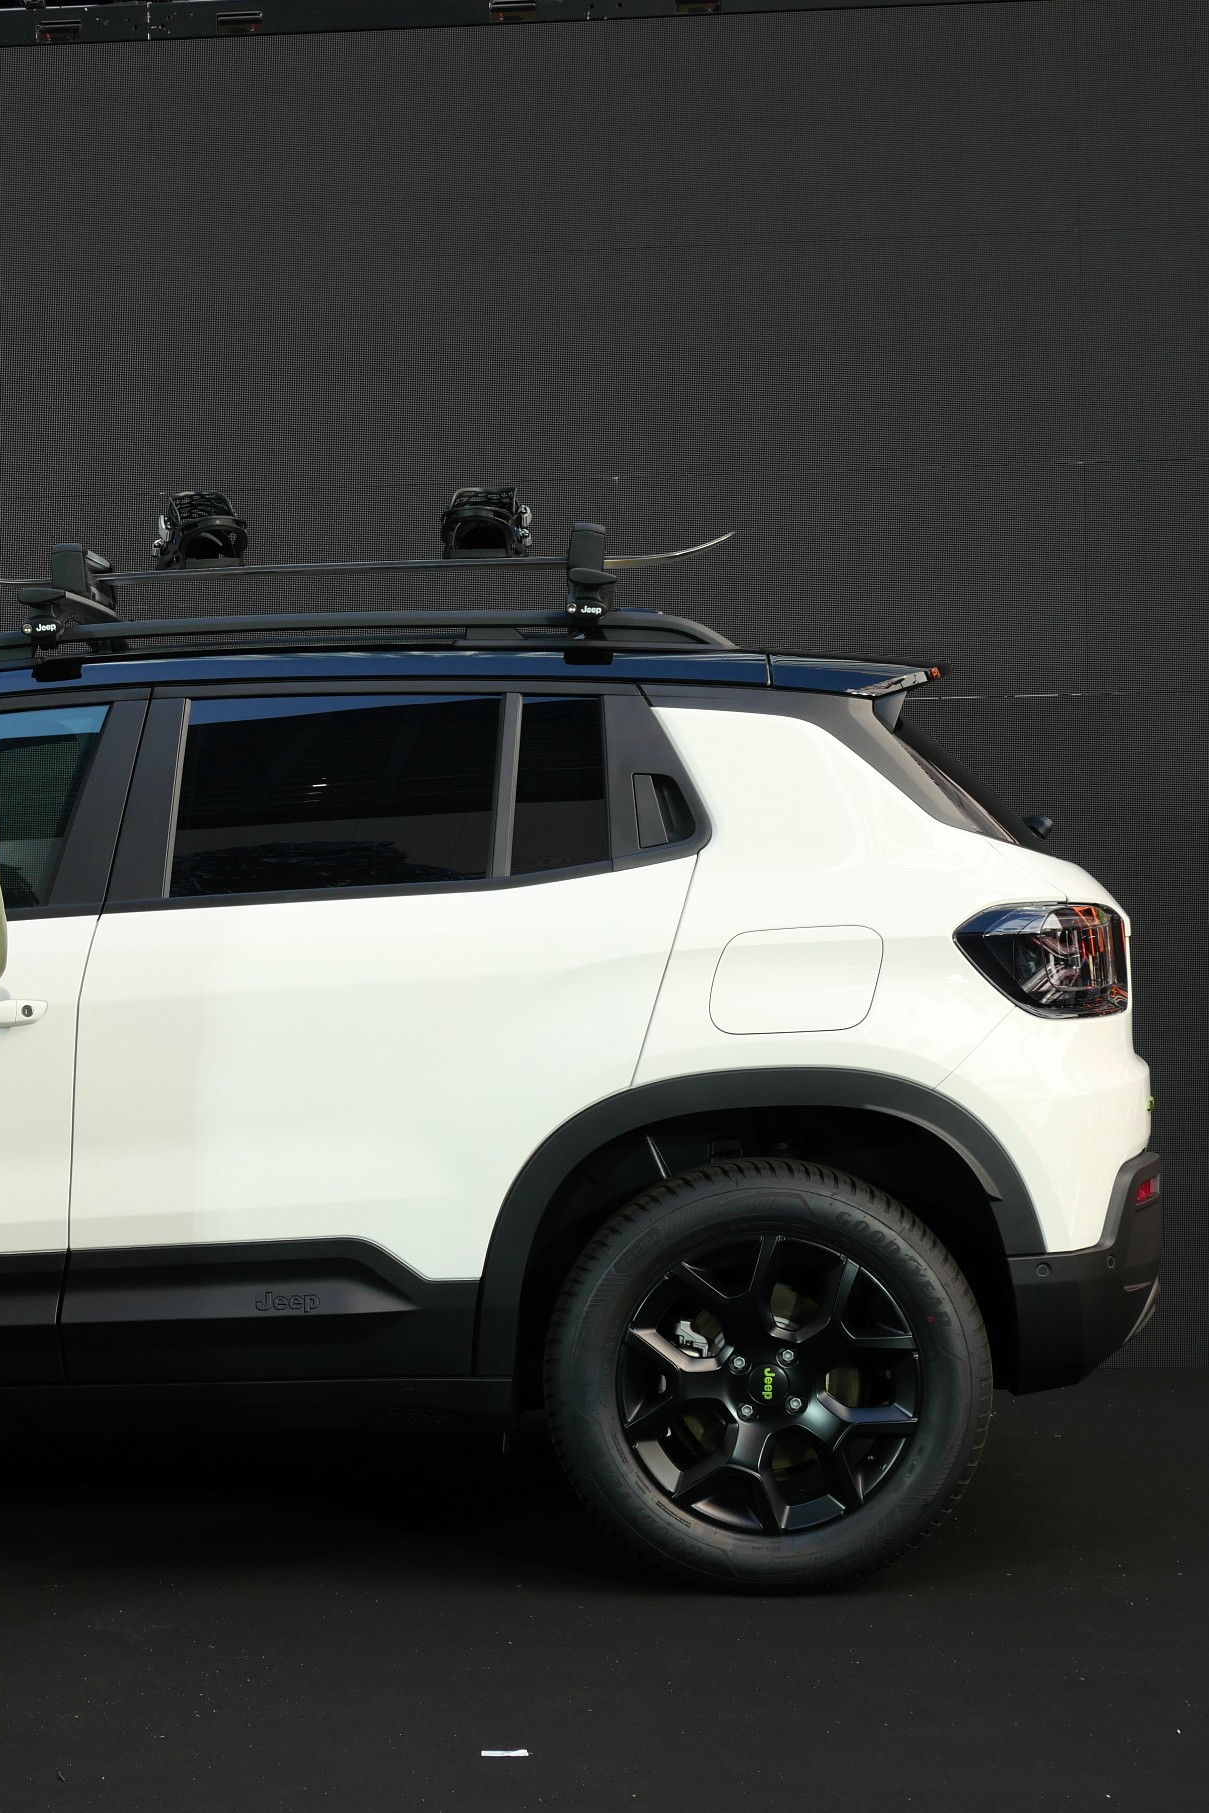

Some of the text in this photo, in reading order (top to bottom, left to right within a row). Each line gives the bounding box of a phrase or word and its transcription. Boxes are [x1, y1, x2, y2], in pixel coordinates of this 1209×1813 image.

[581, 605, 602, 615] Jeep
[35, 623, 57, 632] Jeep
[254, 1291, 320, 1313] Jeep
[762, 1367, 776, 1400] Jeep
